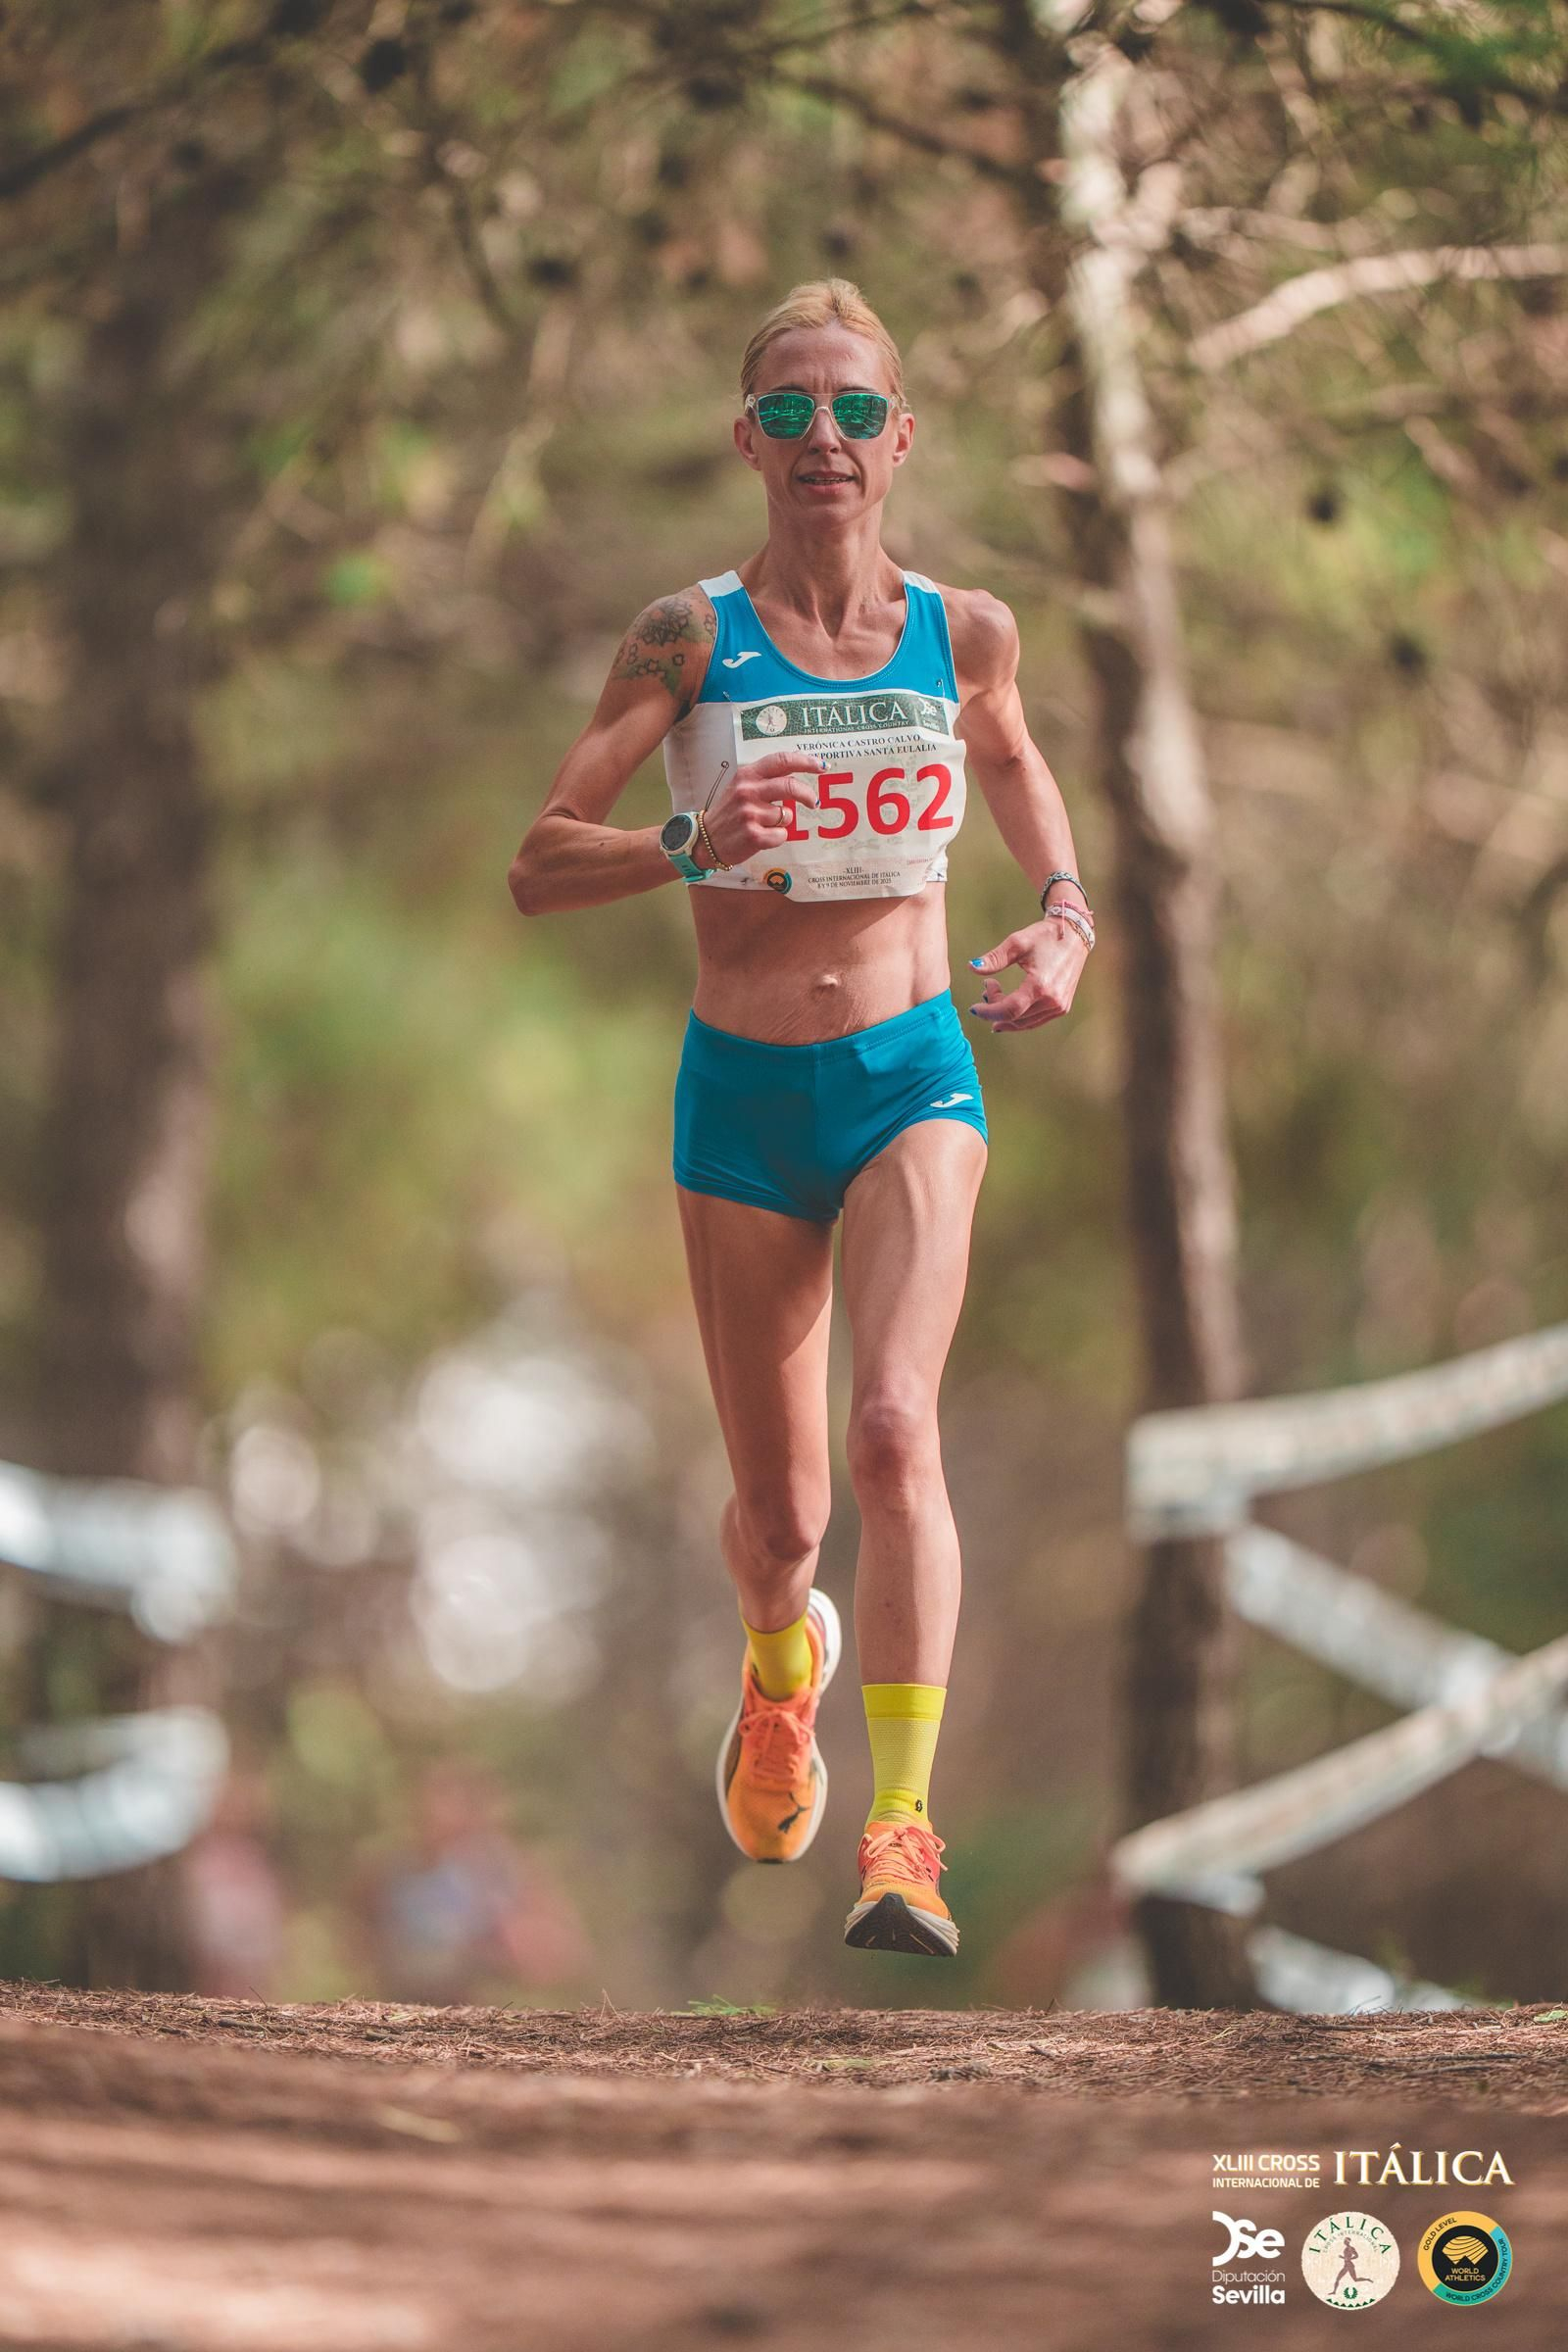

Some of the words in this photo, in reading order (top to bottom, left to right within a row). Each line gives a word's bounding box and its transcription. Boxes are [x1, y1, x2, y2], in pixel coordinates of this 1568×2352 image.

[802, 701, 907, 727] ITÁLICA
[797, 740, 845, 752] VERÓNICA
[848, 737, 885, 747] CASTRO
[888, 733, 920, 743] CALVO
[808, 749, 862, 760] EPORTIVA
[864, 747, 895, 757] SANTA
[897, 743, 937, 754] EULALIA
[826, 873, 870, 882] INTERNACIONAL
